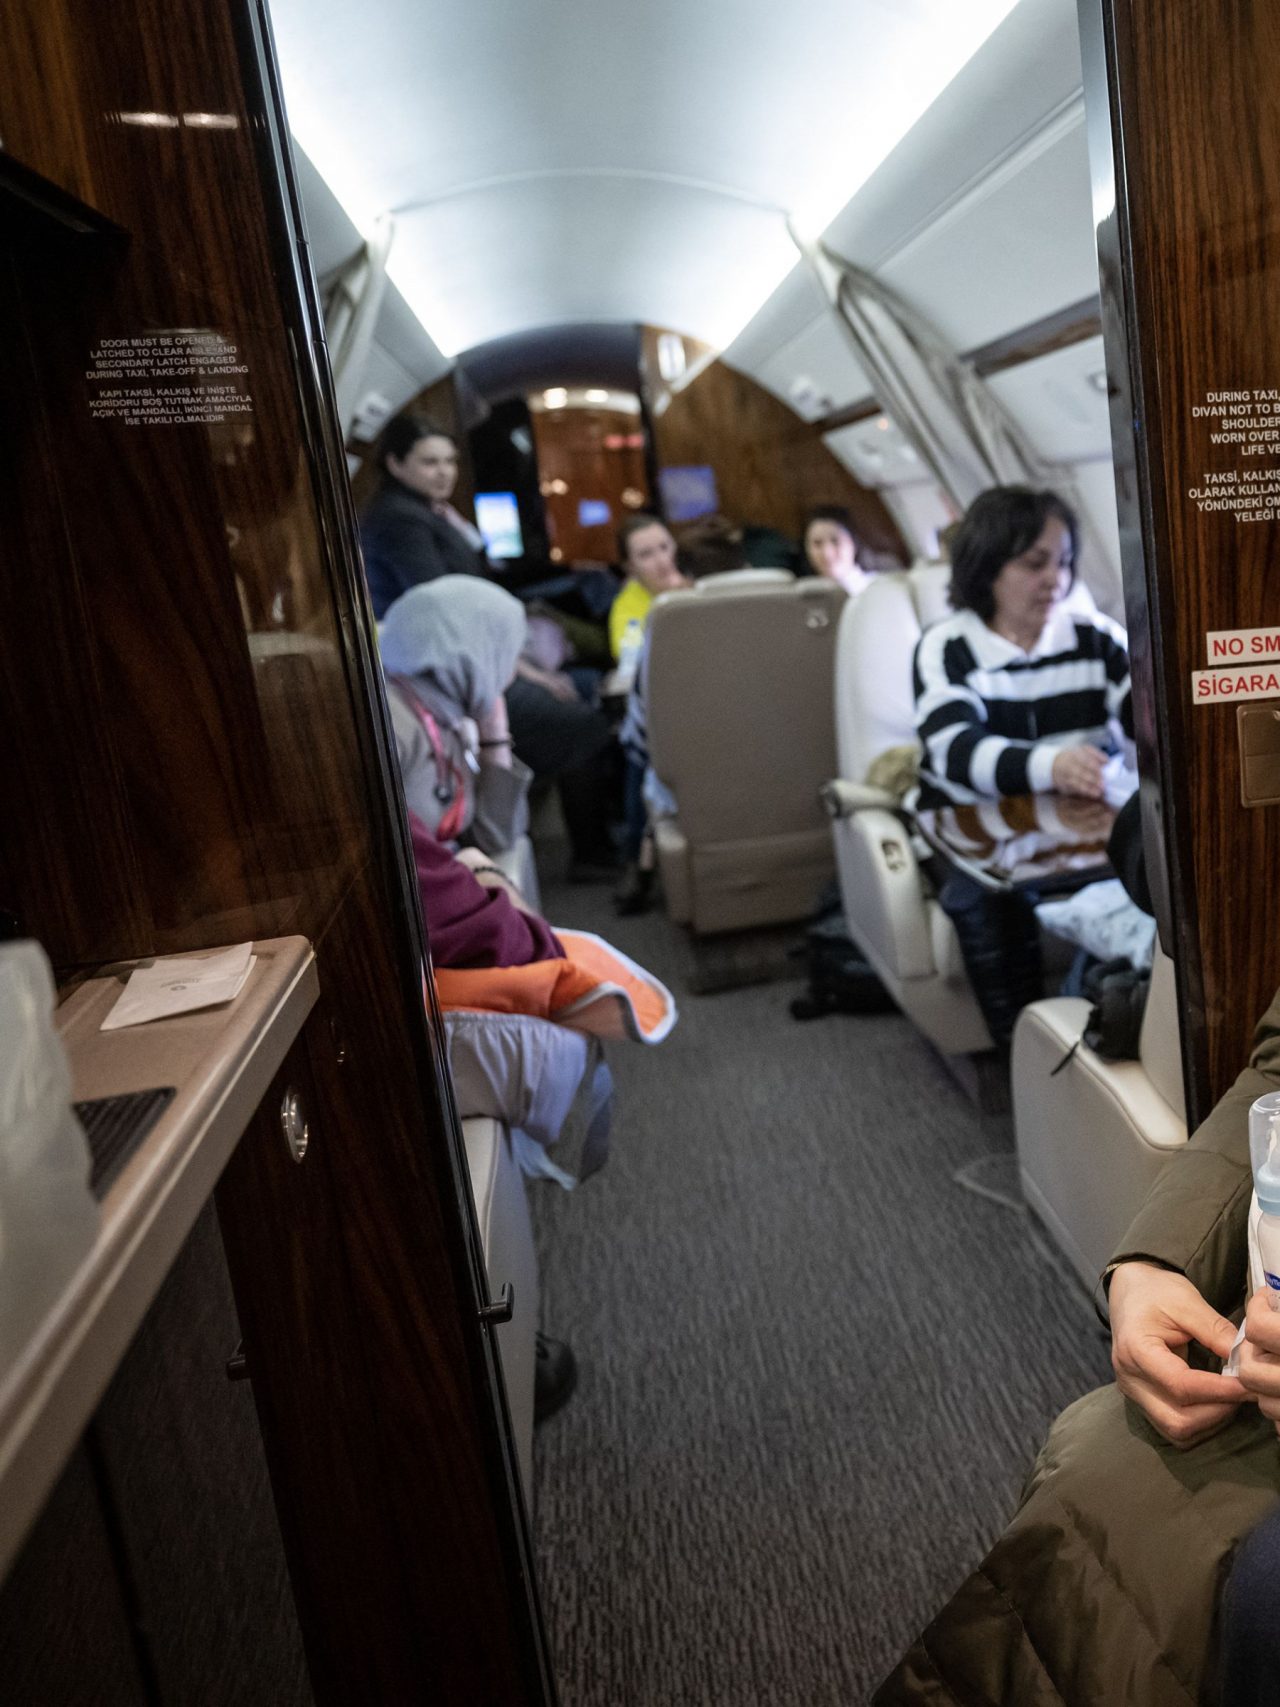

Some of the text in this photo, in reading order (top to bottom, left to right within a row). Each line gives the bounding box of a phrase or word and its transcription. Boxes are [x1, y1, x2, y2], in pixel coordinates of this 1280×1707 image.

[100, 339, 130, 348] DOOR
[130, 337, 158, 347] MUST
[159, 337, 173, 346] BE
[90, 349, 135, 359] LATCHED
[136, 348, 150, 357] TO
[151, 347, 184, 356] CLEAR
[95, 356, 236, 369] SECONDARY LATCH ENGAGED
[86, 365, 249, 379] DURING TAXI, TAKE-OFF & LANDING
[100, 390, 122, 398] KAPI
[193, 387, 205, 395] VE
[1206, 391, 1250, 403] DURING
[1253, 390, 1280, 401] TAXI,
[163, 396, 203, 405] TUTMAK
[205, 395, 252, 403] AMACIYLA
[117, 408, 130, 416] VE
[214, 404, 253, 412] MANDAL
[1192, 406, 1226, 418] DIVAN
[1229, 404, 1252, 416] NOT
[1255, 403, 1271, 414] TO
[142, 416, 172, 424] TAKILI
[174, 414, 225, 423] OLMALIDIR
[1210, 432, 1246, 444] WORN
[1248, 430, 1280, 442] OVER
[1241, 444, 1266, 456] LIFE
[1203, 470, 1240, 484] TAKSİ,
[1188, 486, 1236, 499] OLARAK
[1196, 496, 1263, 512] YÖNÜNDEKİ
[1234, 508, 1275, 523] YELEĞİ
[1213, 637, 1244, 657] NO
[1198, 673, 1280, 697] SİGARA
